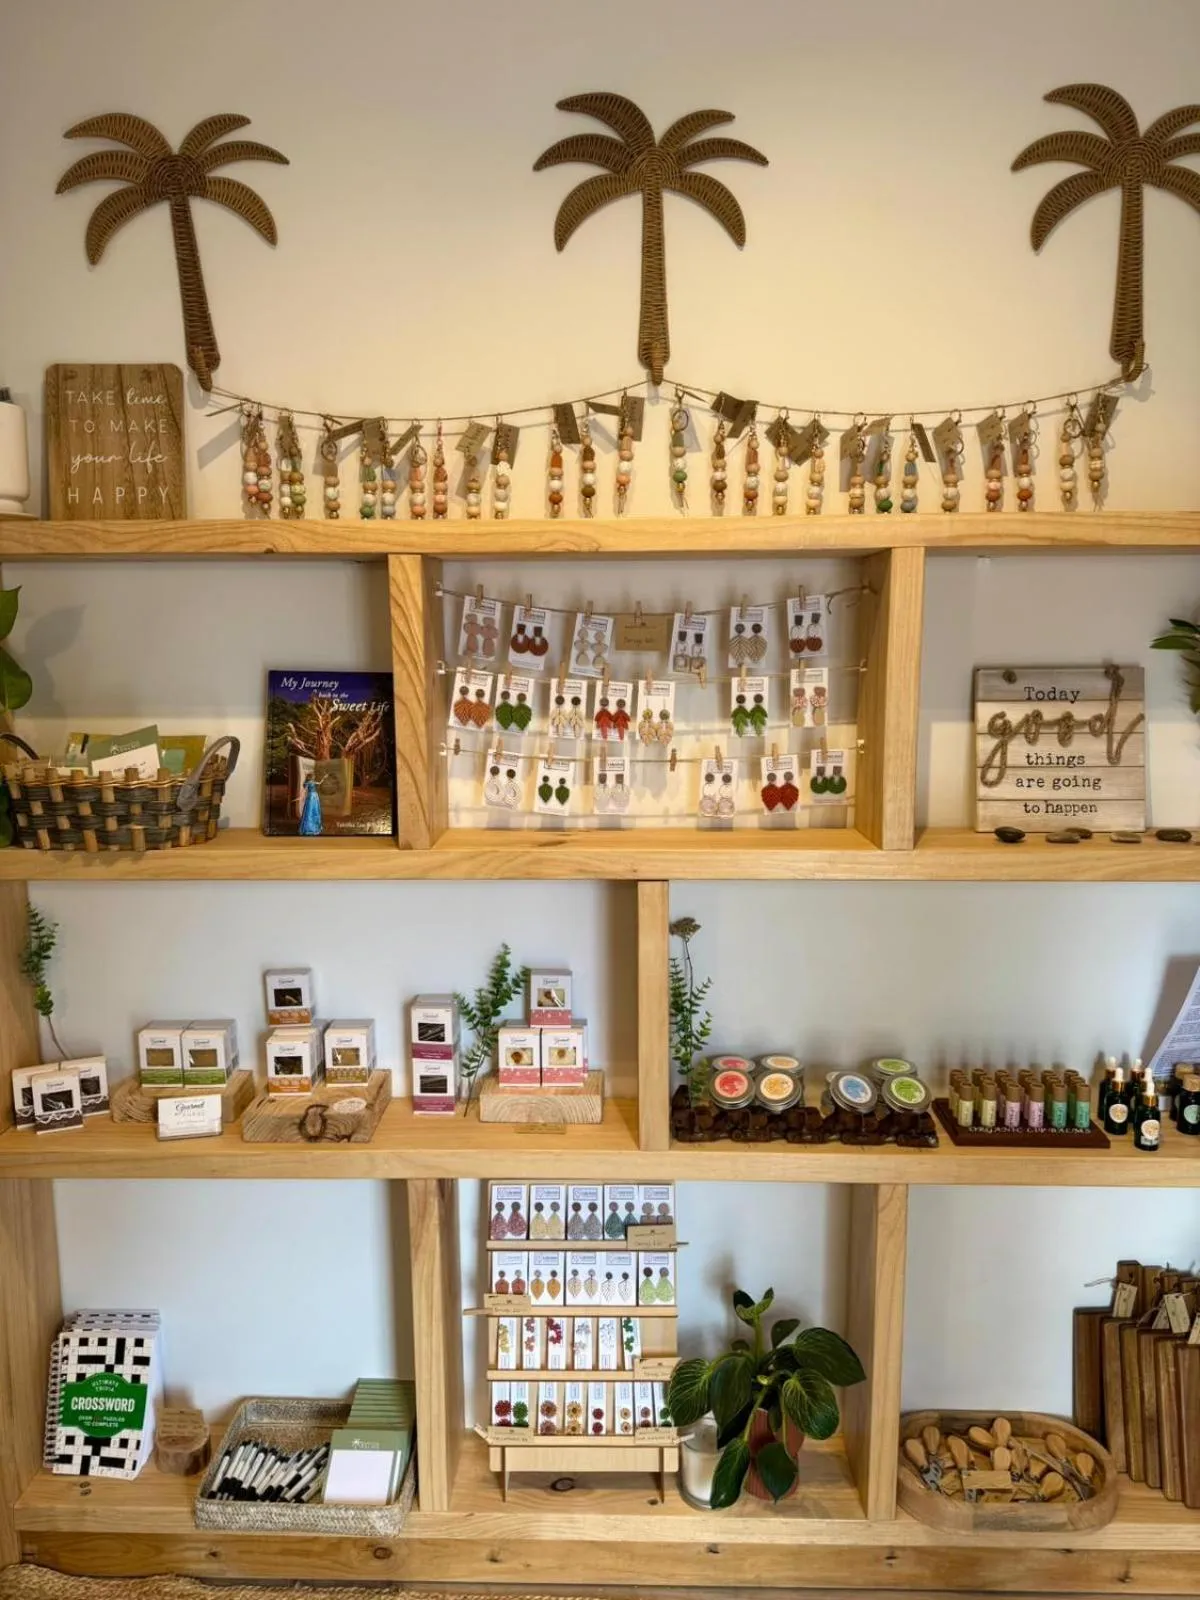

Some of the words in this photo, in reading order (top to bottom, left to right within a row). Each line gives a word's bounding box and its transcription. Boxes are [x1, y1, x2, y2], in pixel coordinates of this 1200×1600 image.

[65, 390, 115, 406] TAKE
[127, 386, 167, 406] time
[68, 418, 95, 435] TO
[110, 417, 170, 435] MAKE
[70, 451, 122, 475] your
[128, 440, 169, 475] life
[67, 485, 171, 506] HAPPY
[280, 676, 298, 691] My
[299, 676, 339, 691] Journey
[1023, 685, 1081, 703] Today
[331, 697, 367, 713] Sweet
[369, 700, 391, 714] Life
[980, 662, 1145, 788] good
[1025, 751, 1086, 769] things
[1015, 777, 1046, 789] are
[1052, 776, 1102, 791] going
[1023, 802, 1040, 814] to
[1044, 800, 1098, 817] happen
[71, 1397, 135, 1412] CROSSWORD
